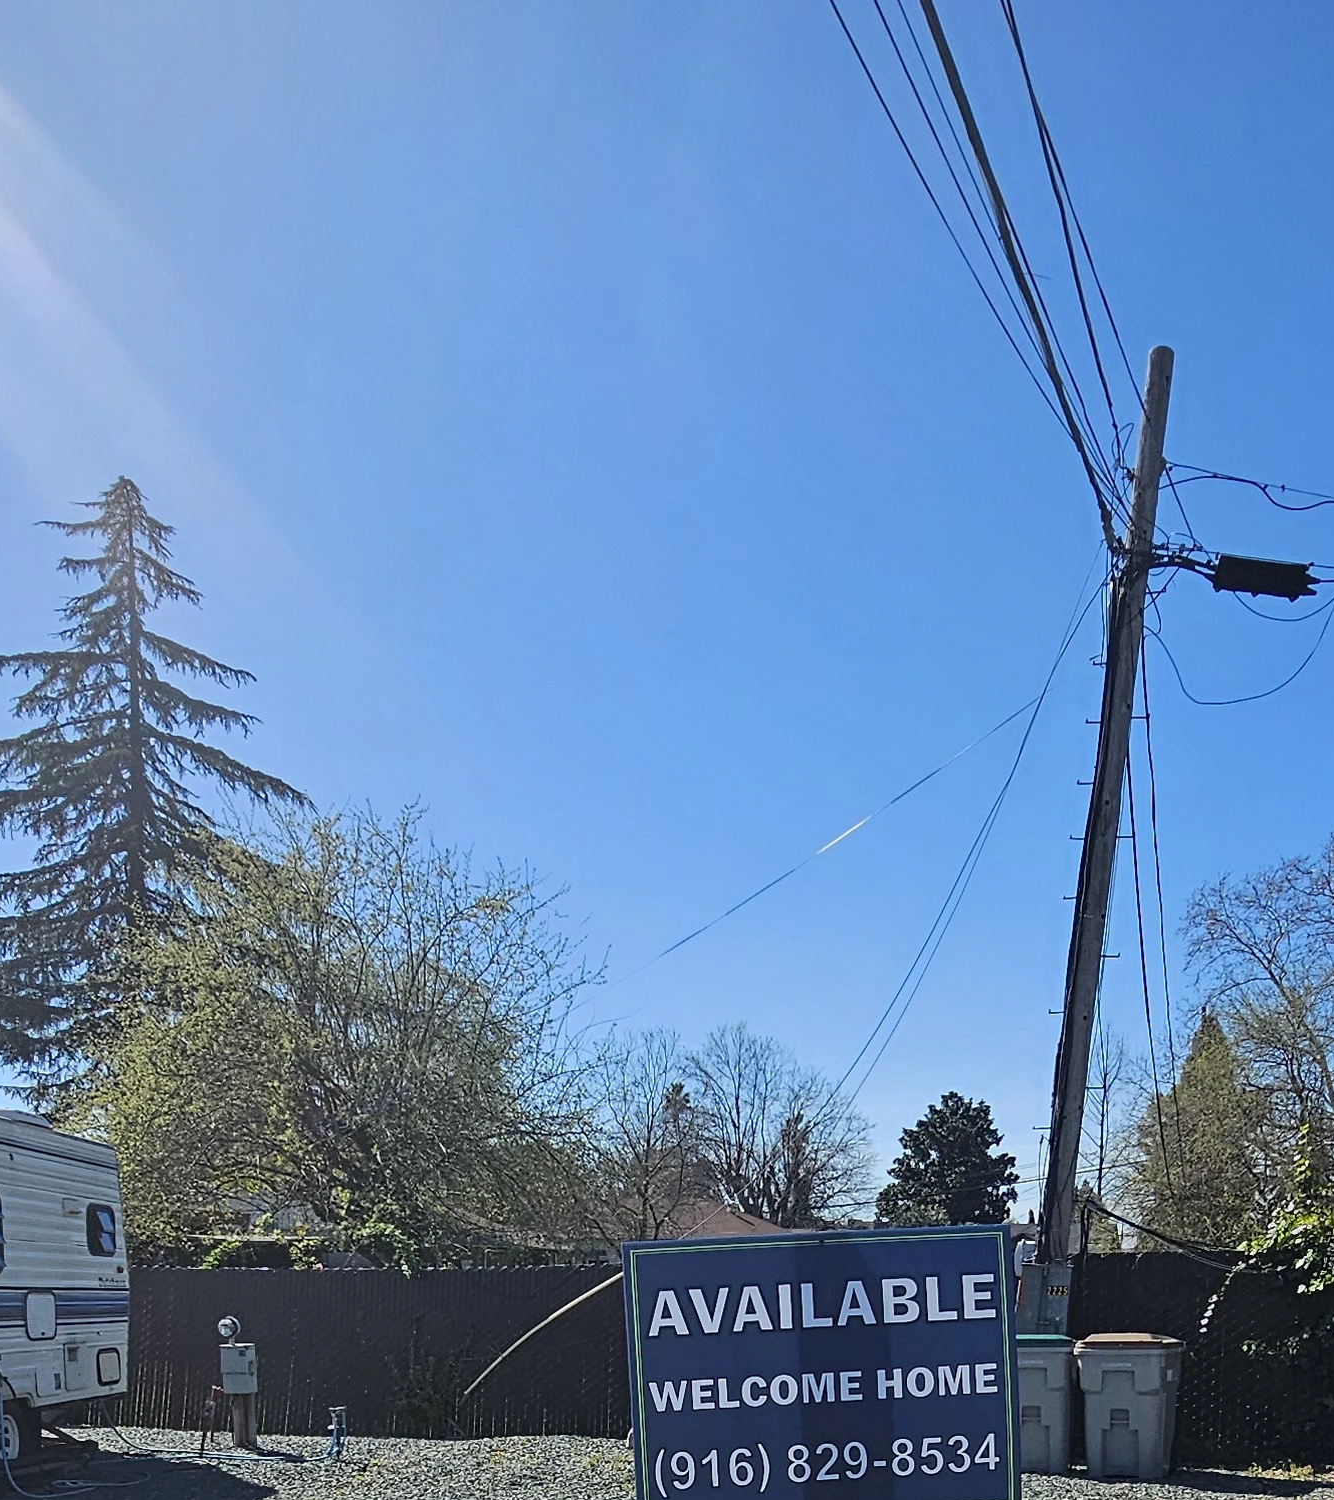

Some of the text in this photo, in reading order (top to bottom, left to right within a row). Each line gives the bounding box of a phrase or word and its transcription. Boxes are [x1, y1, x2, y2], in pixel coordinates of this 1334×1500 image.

[648, 1273, 997, 1338] AVAILABLE
[648, 1363, 999, 1413] WELCOME HOME
[655, 1433, 1001, 1498] (916) 829-8534
